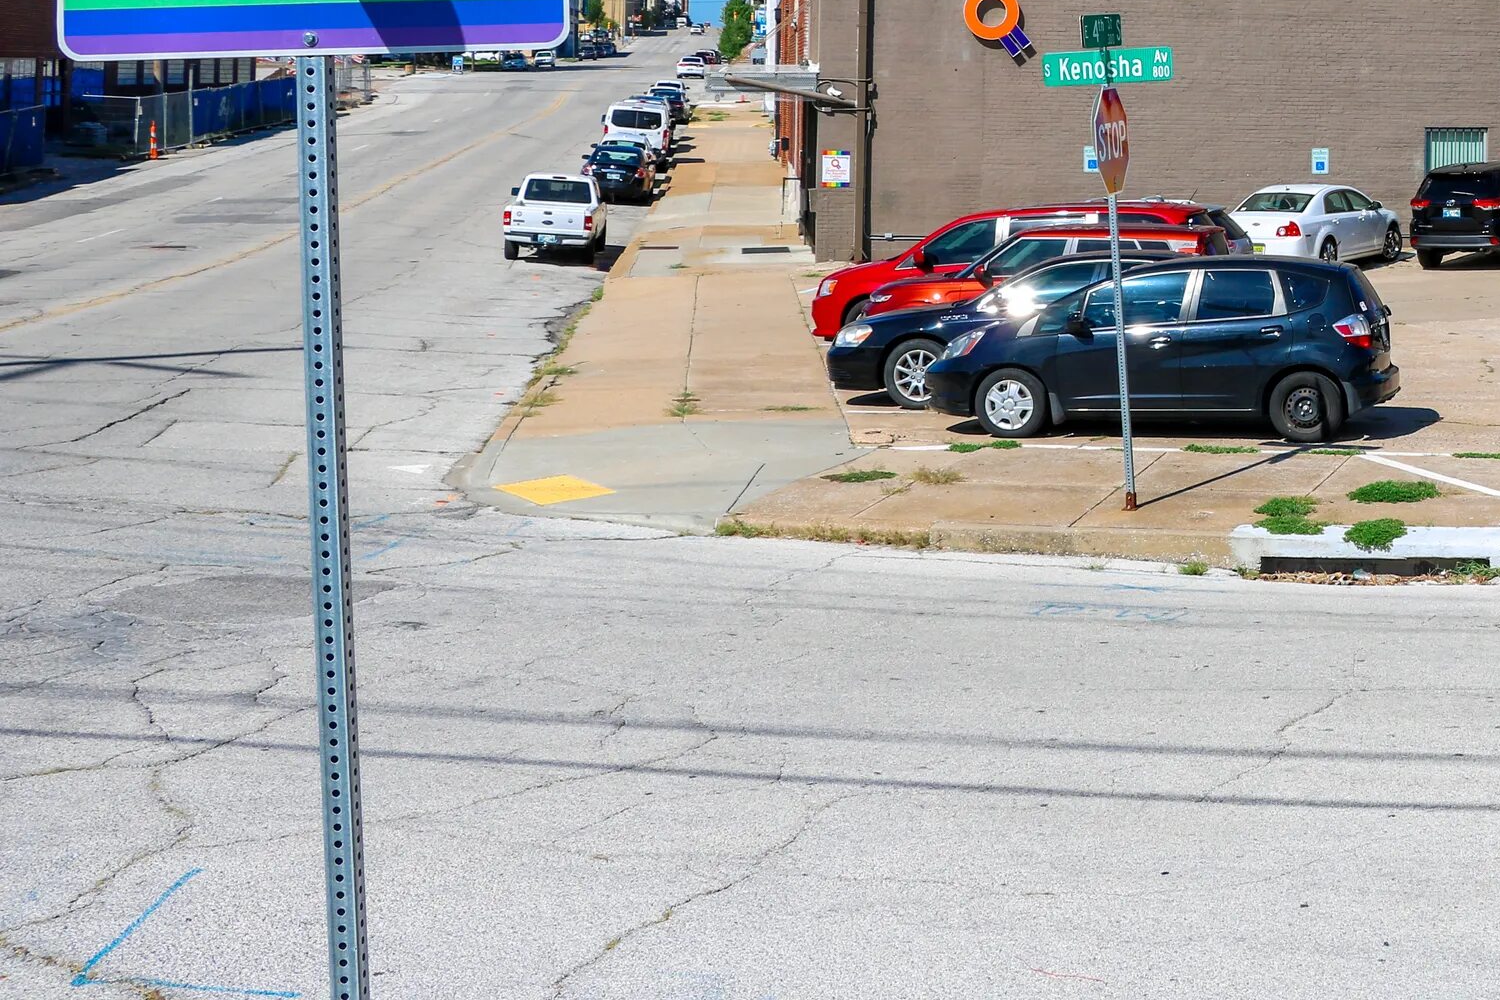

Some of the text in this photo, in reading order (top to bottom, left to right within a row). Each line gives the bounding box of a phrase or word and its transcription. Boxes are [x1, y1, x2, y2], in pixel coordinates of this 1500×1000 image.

[1092, 18, 1105, 43] 4th
[1044, 48, 1168, 81] S Kenosha Av
[1152, 65, 1170, 78] 800
[1098, 120, 1127, 162] STOP
